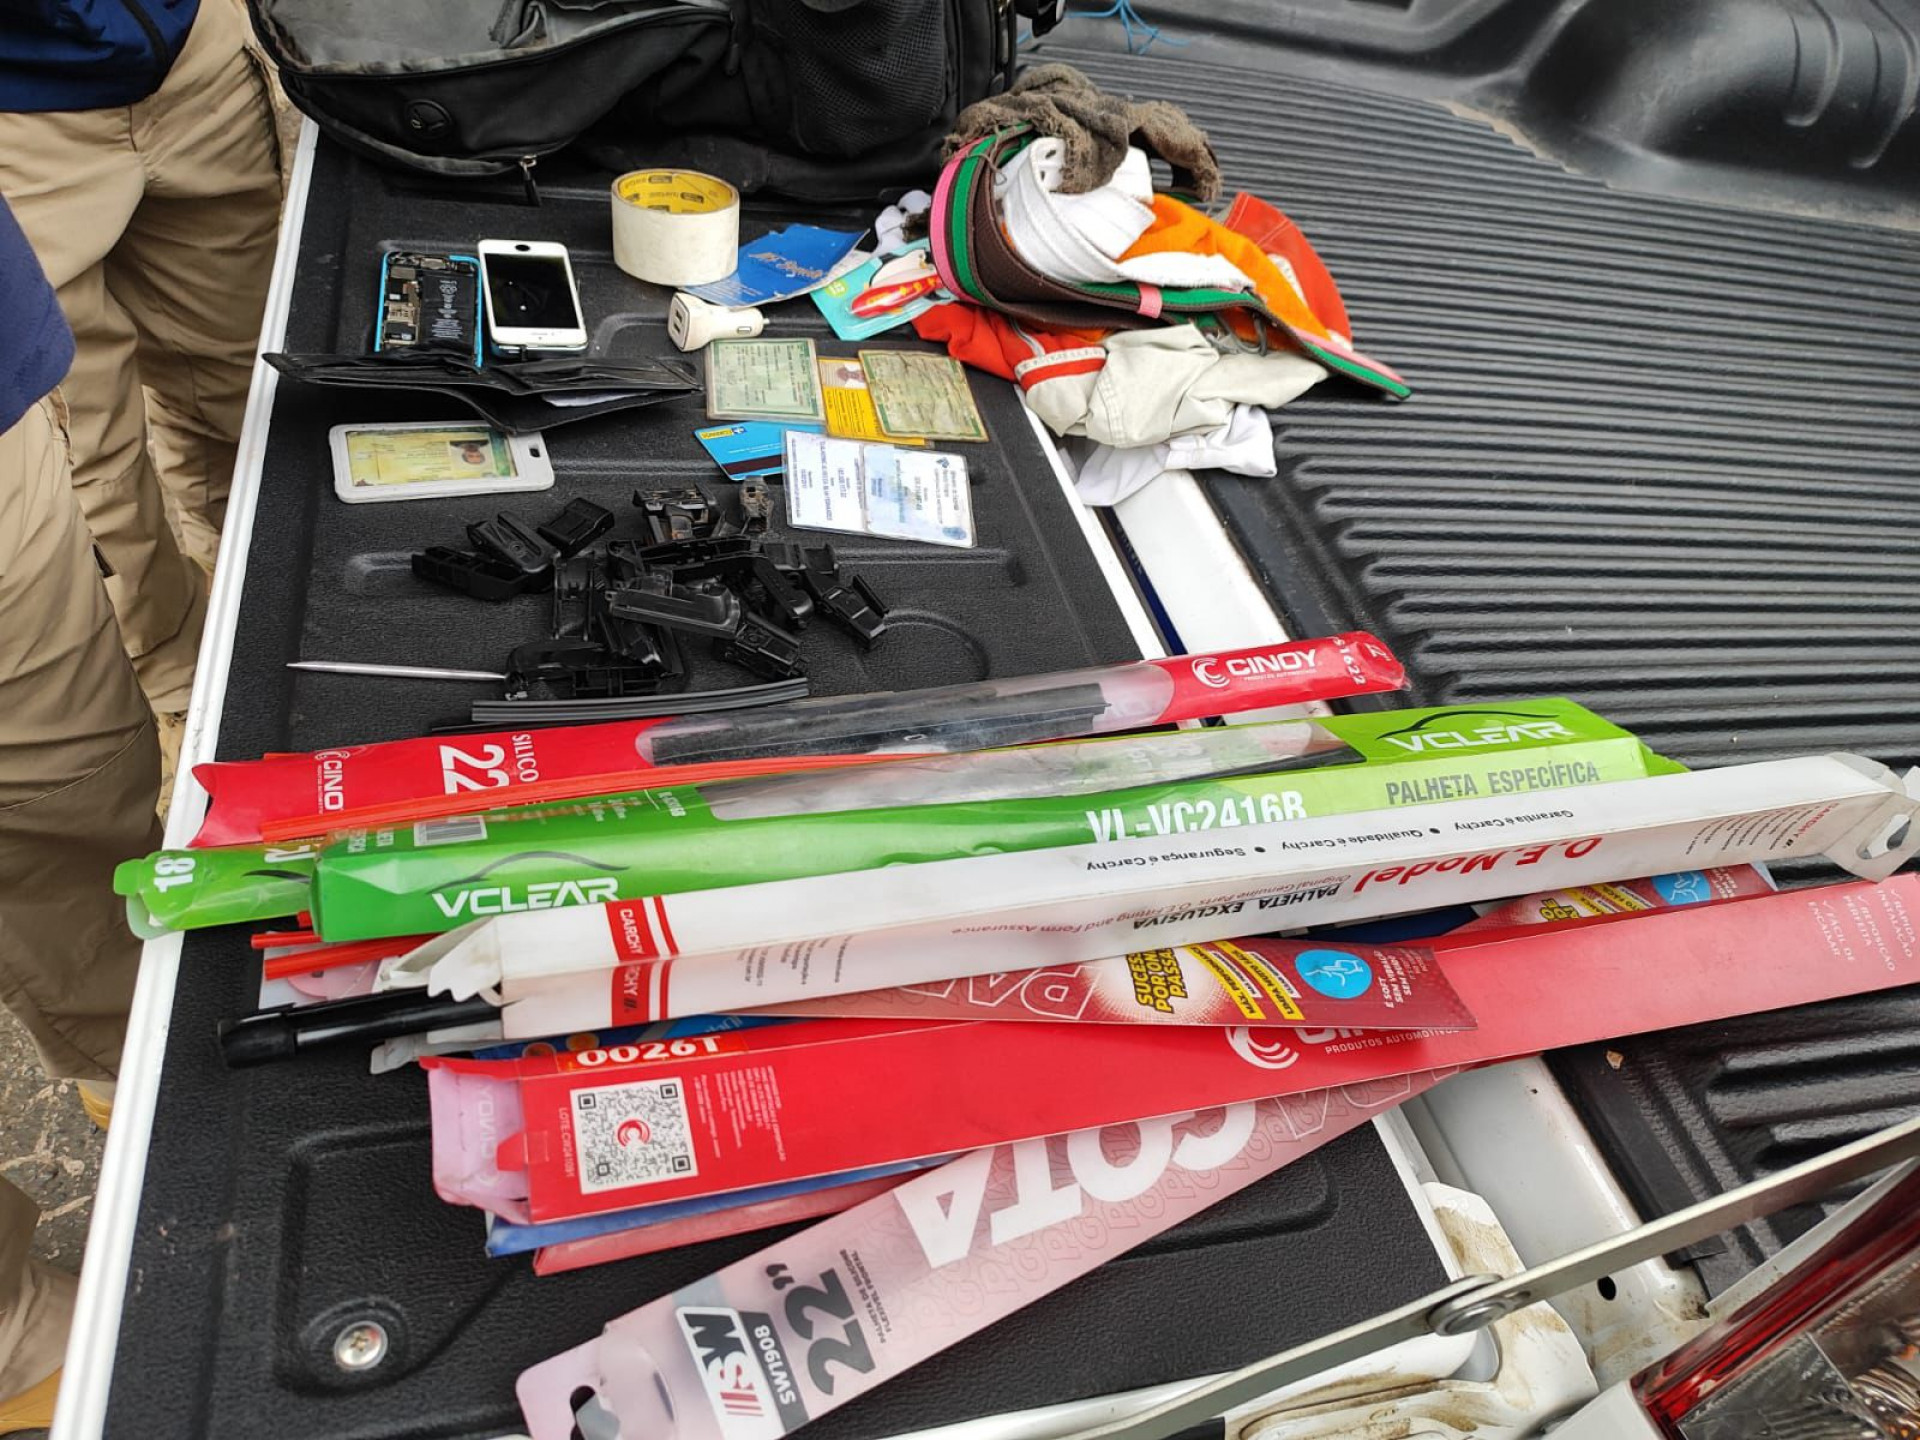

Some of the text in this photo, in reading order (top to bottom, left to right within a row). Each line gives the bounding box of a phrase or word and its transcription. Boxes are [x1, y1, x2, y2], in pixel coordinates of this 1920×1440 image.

[1225, 648, 1316, 676] CINOY
[1332, 636, 1366, 685] S1622
[512, 733, 540, 783] SILICO
[1385, 721, 1575, 752] VCLEAR
[323, 760, 344, 811] CINO
[1387, 761, 1600, 806] PALHETA ESPECÍFICA
[1349, 828, 1423, 845] Qualidade
[1454, 816, 1504, 832] Carchy
[1516, 809, 1575, 825] Garantia
[1086, 856, 1147, 872] Carchy
[1162, 846, 1247, 863] Segurança
[1281, 836, 1335, 851] Carchy
[432, 877, 619, 918] VCLEAR
[1133, 882, 1341, 931] PALHETA EXCLUSIVA
[618, 907, 643, 954] CARCHY
[1808, 901, 1842, 956] ENCAIXAR
[1825, 911, 1855, 961] FÁCIL DE
[1843, 894, 1873, 947] PERFEITA
[1860, 906, 1896, 972] REPOSIÇÃO
[1877, 889, 1913, 958] INSTALAÇÃO
[1126, 949, 1157, 1006] SUCES
[1151, 978, 1174, 1014] POR
[1378, 976, 1392, 998] SOFT
[1392, 983, 1403, 1002] SEM
[1400, 977, 1410, 994] SEM
[1325, 1039, 1384, 1056] PRODUTOS
[839, 1248, 887, 1343] PALHETA DE SILICONE
[850, 1250, 892, 1332] FLEXÍVEL FRONTAL
[753, 1324, 797, 1405] SW1908
